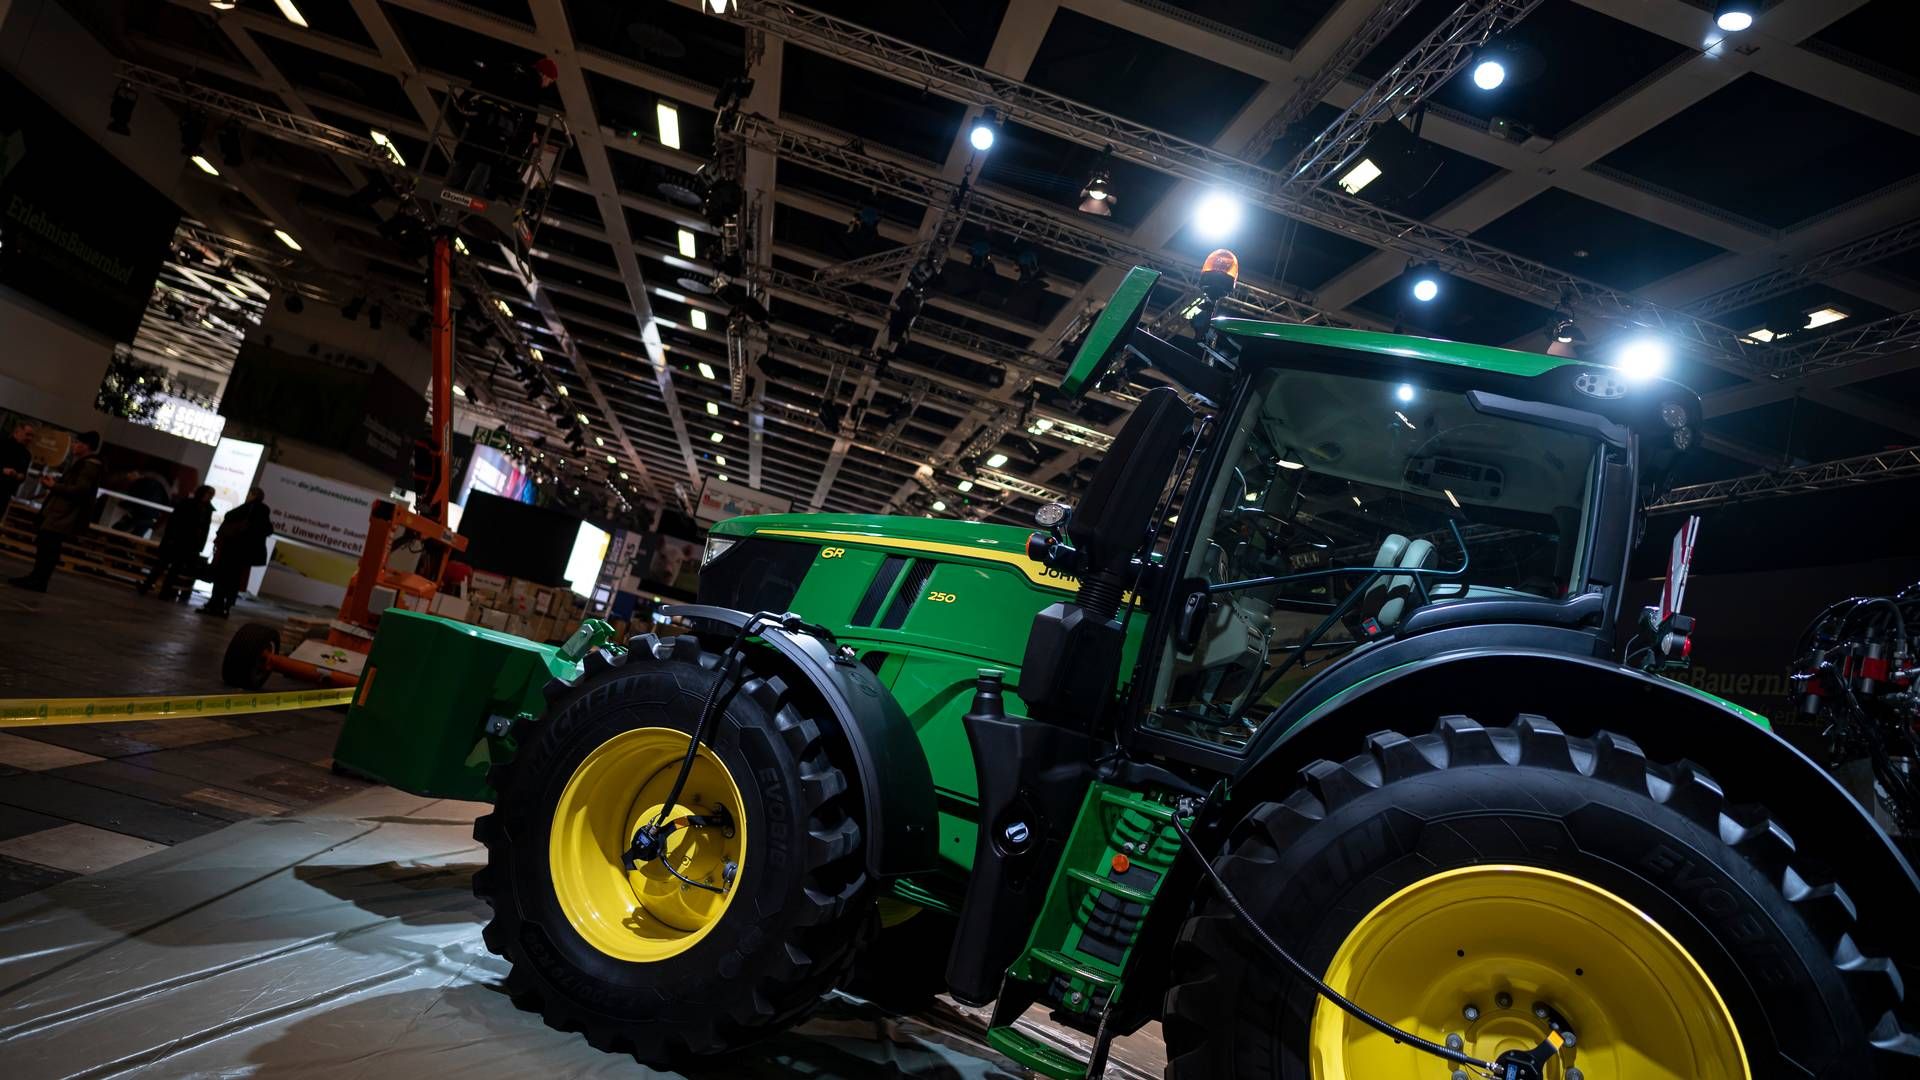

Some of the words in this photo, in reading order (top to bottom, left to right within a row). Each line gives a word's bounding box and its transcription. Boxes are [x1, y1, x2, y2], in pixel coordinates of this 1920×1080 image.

[292, 524, 363, 553] Umweltgerecht
[821, 546, 845, 559] 6R
[927, 591, 957, 603] 250
